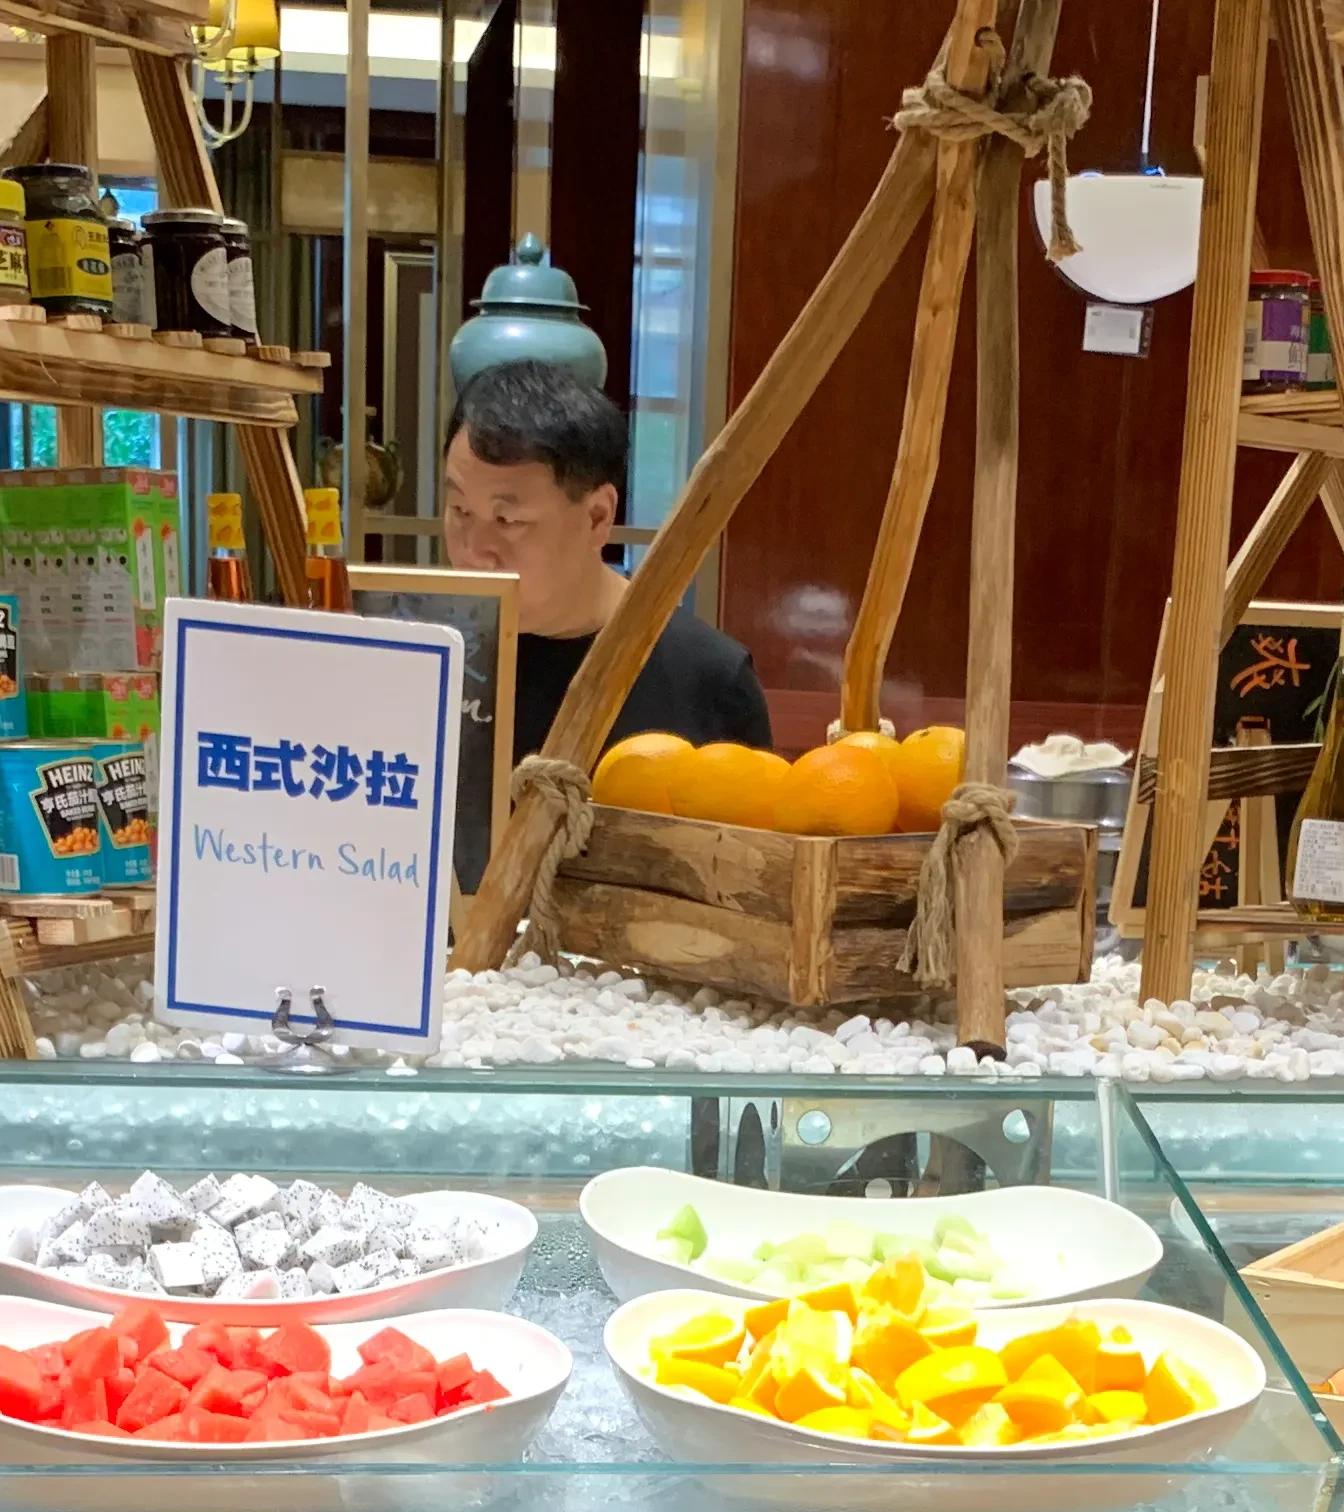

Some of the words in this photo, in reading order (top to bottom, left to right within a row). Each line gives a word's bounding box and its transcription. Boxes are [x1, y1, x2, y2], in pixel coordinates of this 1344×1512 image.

[108, 758, 145, 781] HEIN
[198, 731, 419, 810] 西式沙拉
[194, 824, 325, 873] Western
[338, 843, 420, 888] Salad
